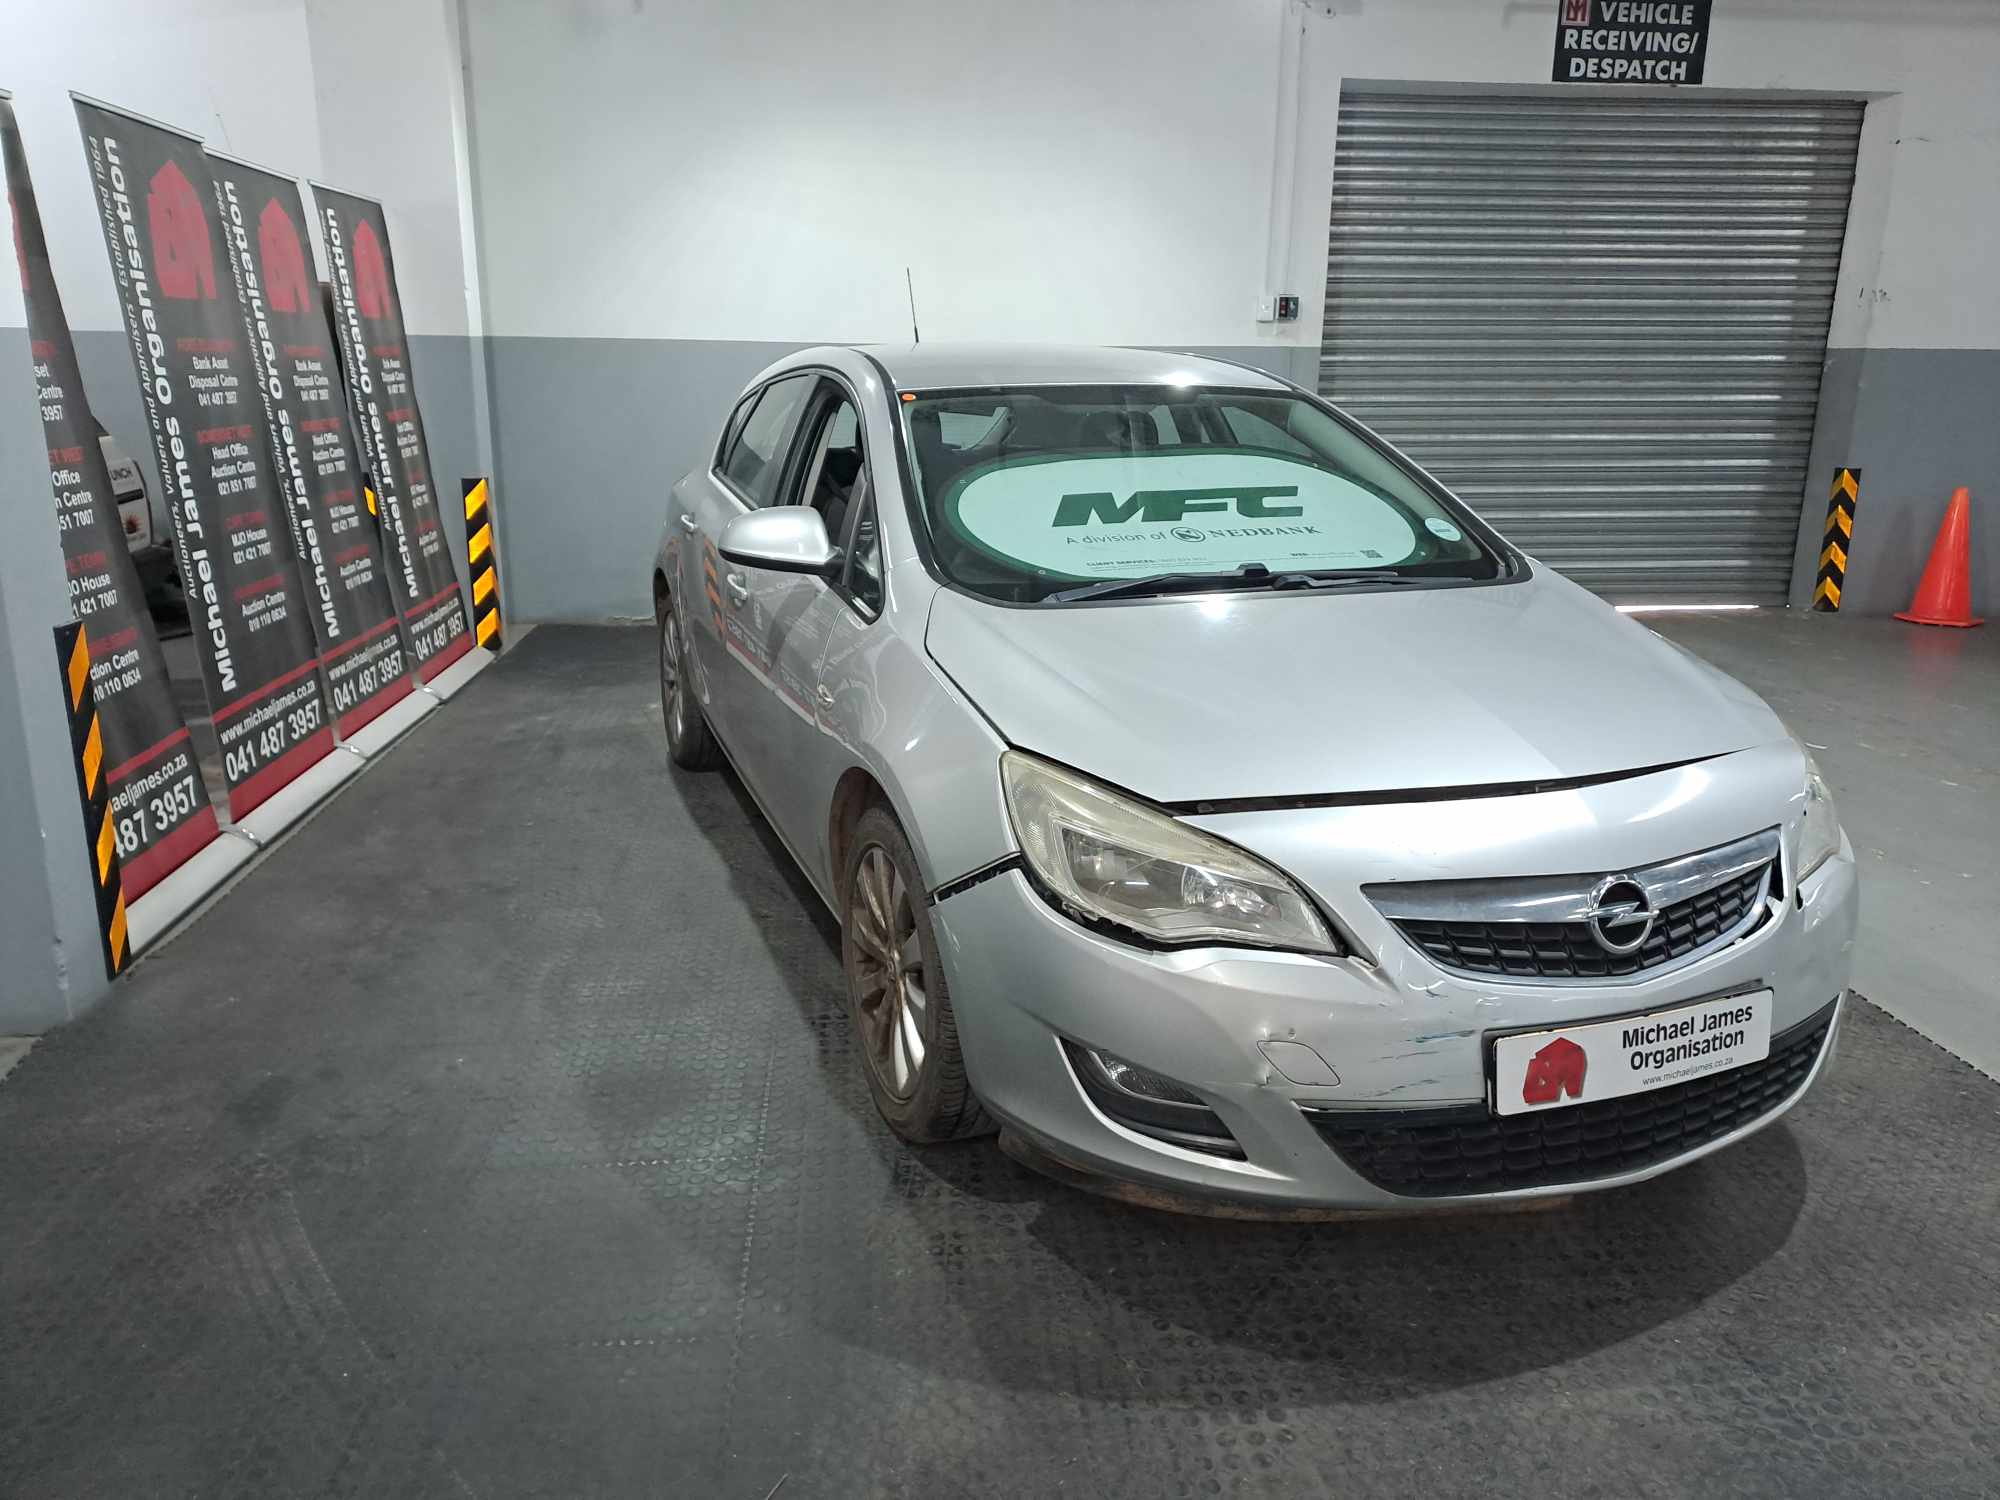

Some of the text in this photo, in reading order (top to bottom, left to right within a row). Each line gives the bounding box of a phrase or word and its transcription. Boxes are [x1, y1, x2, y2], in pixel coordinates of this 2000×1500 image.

[1563, 29, 1700, 54] RECEIVING/
[1600, 1, 1694, 25] VEHICLE
[1569, 57, 1687, 81] DESPATCH
[98, 184, 128, 287] Established
[223, 180, 282, 400] Organisation
[326, 207, 372, 395] Organisation
[126, 303, 153, 394] Appraisers
[103, 136, 237, 692] Michael James Organisation
[145, 396, 160, 430] and
[278, 409, 310, 510] James
[367, 402, 394, 489] James
[52, 469, 80, 487] Office
[1052, 485, 1304, 527] MFC
[171, 501, 197, 599] Auctioneers,
[387, 496, 419, 598] Michael
[1066, 525, 1321, 545] A division of NEDBANK
[80, 573, 111, 592] House
[301, 518, 341, 637] Michael
[415, 633, 435, 661] 041
[433, 623, 447, 649] 487
[333, 650, 404, 712] 041 487 3957
[220, 680, 316, 745] www.michaeljames.co.za
[225, 698, 320, 781] 041 487 3957
[111, 753, 188, 814] aeljames.co.za
[150, 774, 198, 832] 3957
[1621, 1004, 1753, 1050] Michael James
[1630, 1027, 1744, 1071] Organisation
[1641, 1055, 1734, 1088] www.michaeljames.co.za
